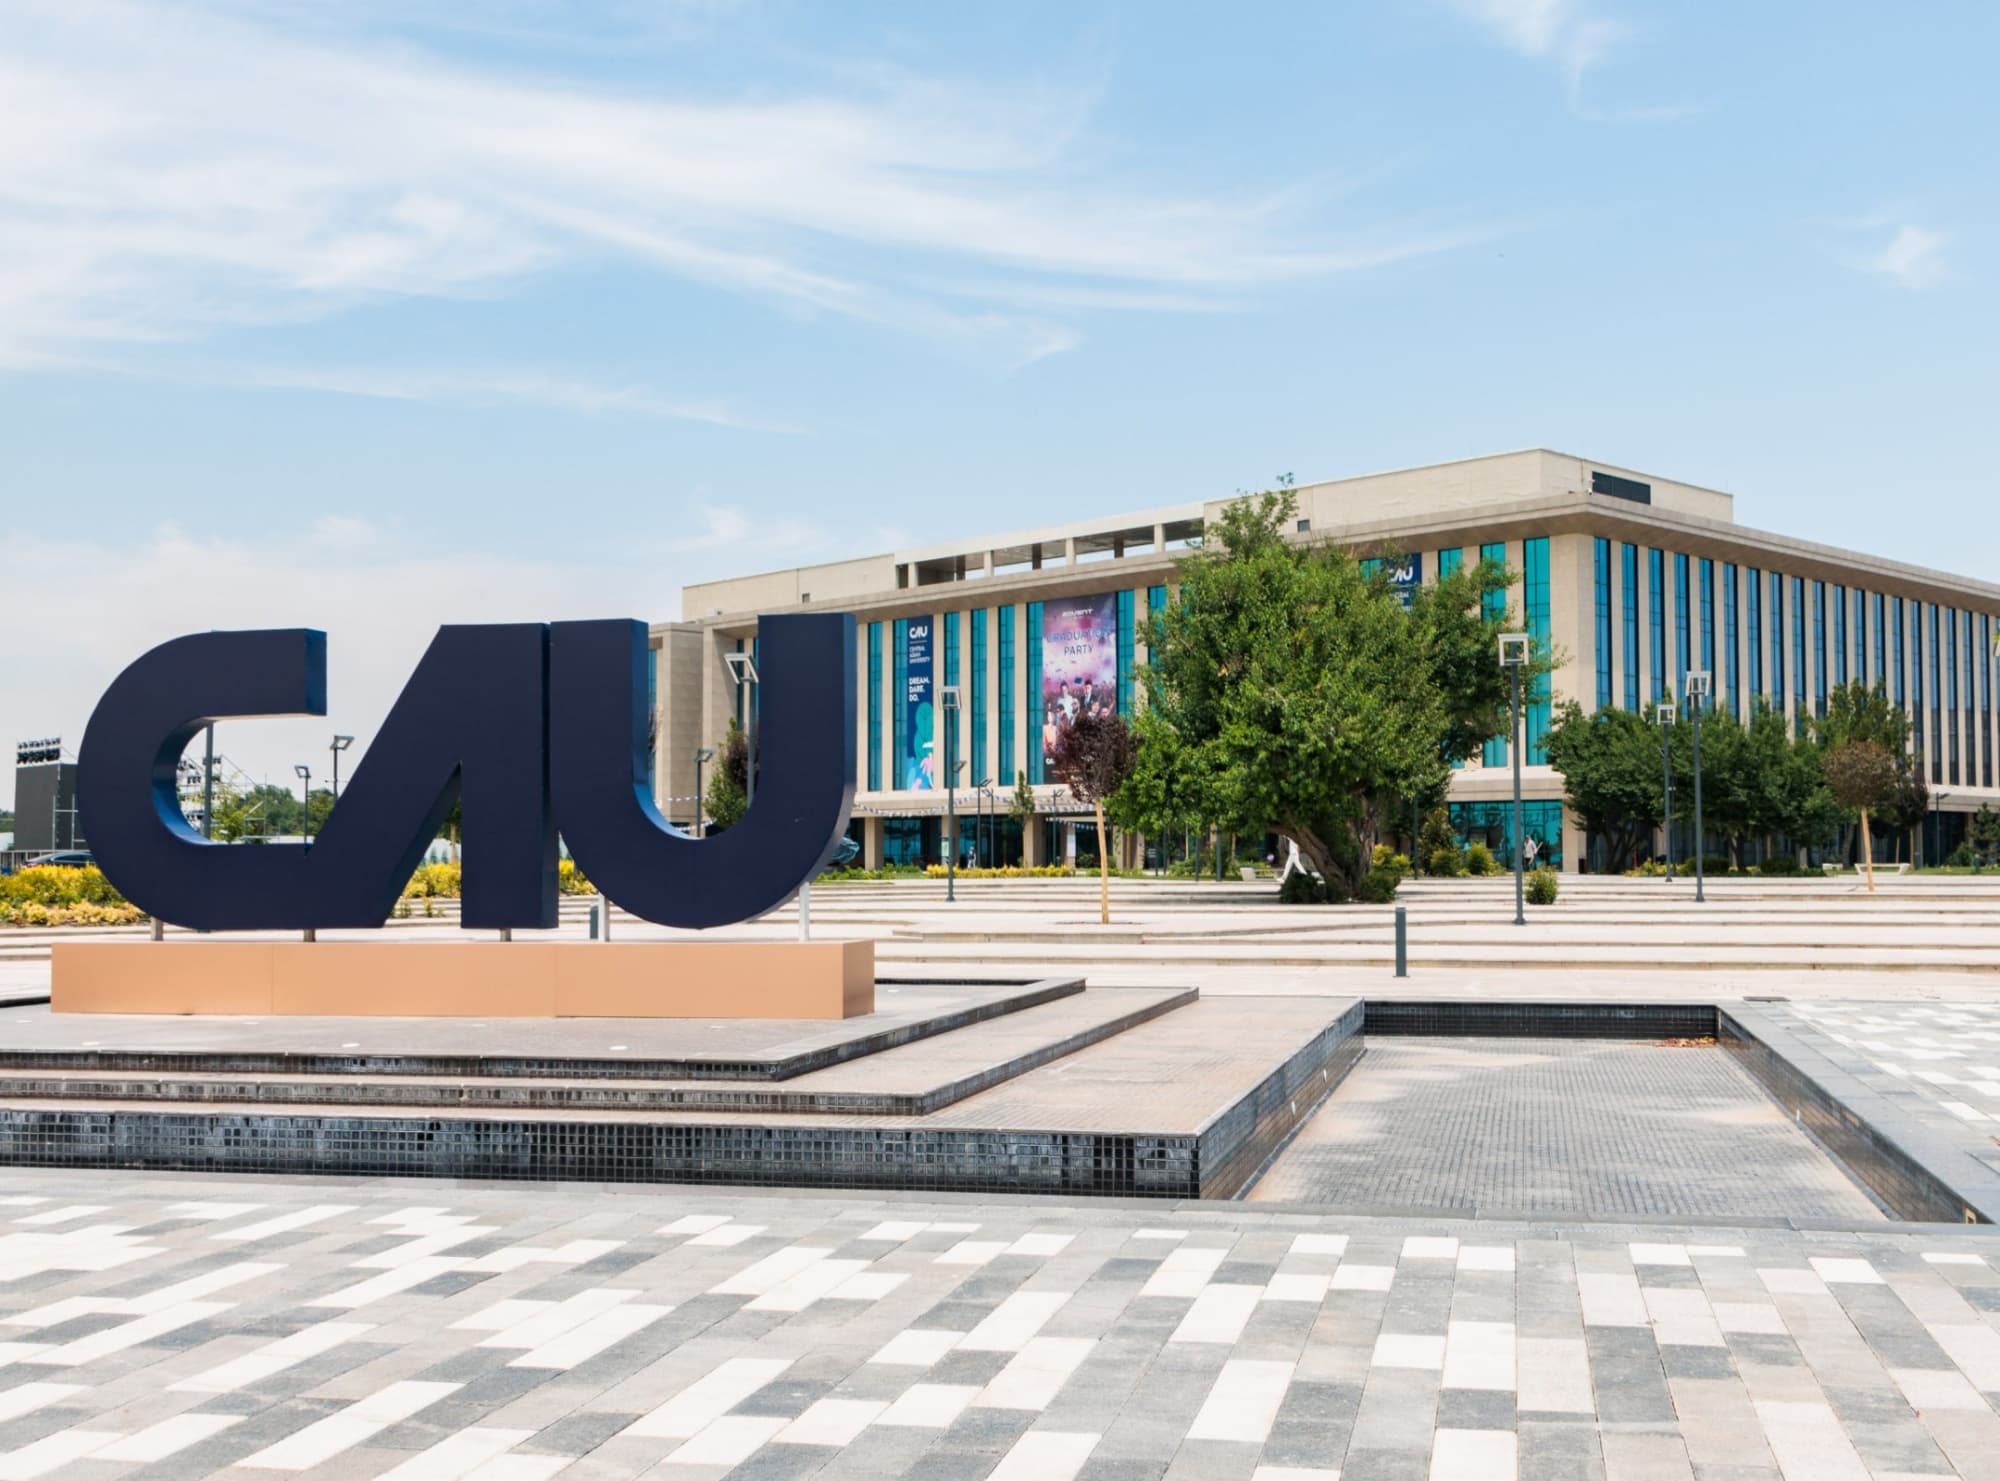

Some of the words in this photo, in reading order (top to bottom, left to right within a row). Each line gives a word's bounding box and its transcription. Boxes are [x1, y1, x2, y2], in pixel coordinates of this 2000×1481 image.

[909, 625, 928, 639] CAU
[1064, 644, 1092, 656] PARTY
[77, 613, 858, 931] CAU
